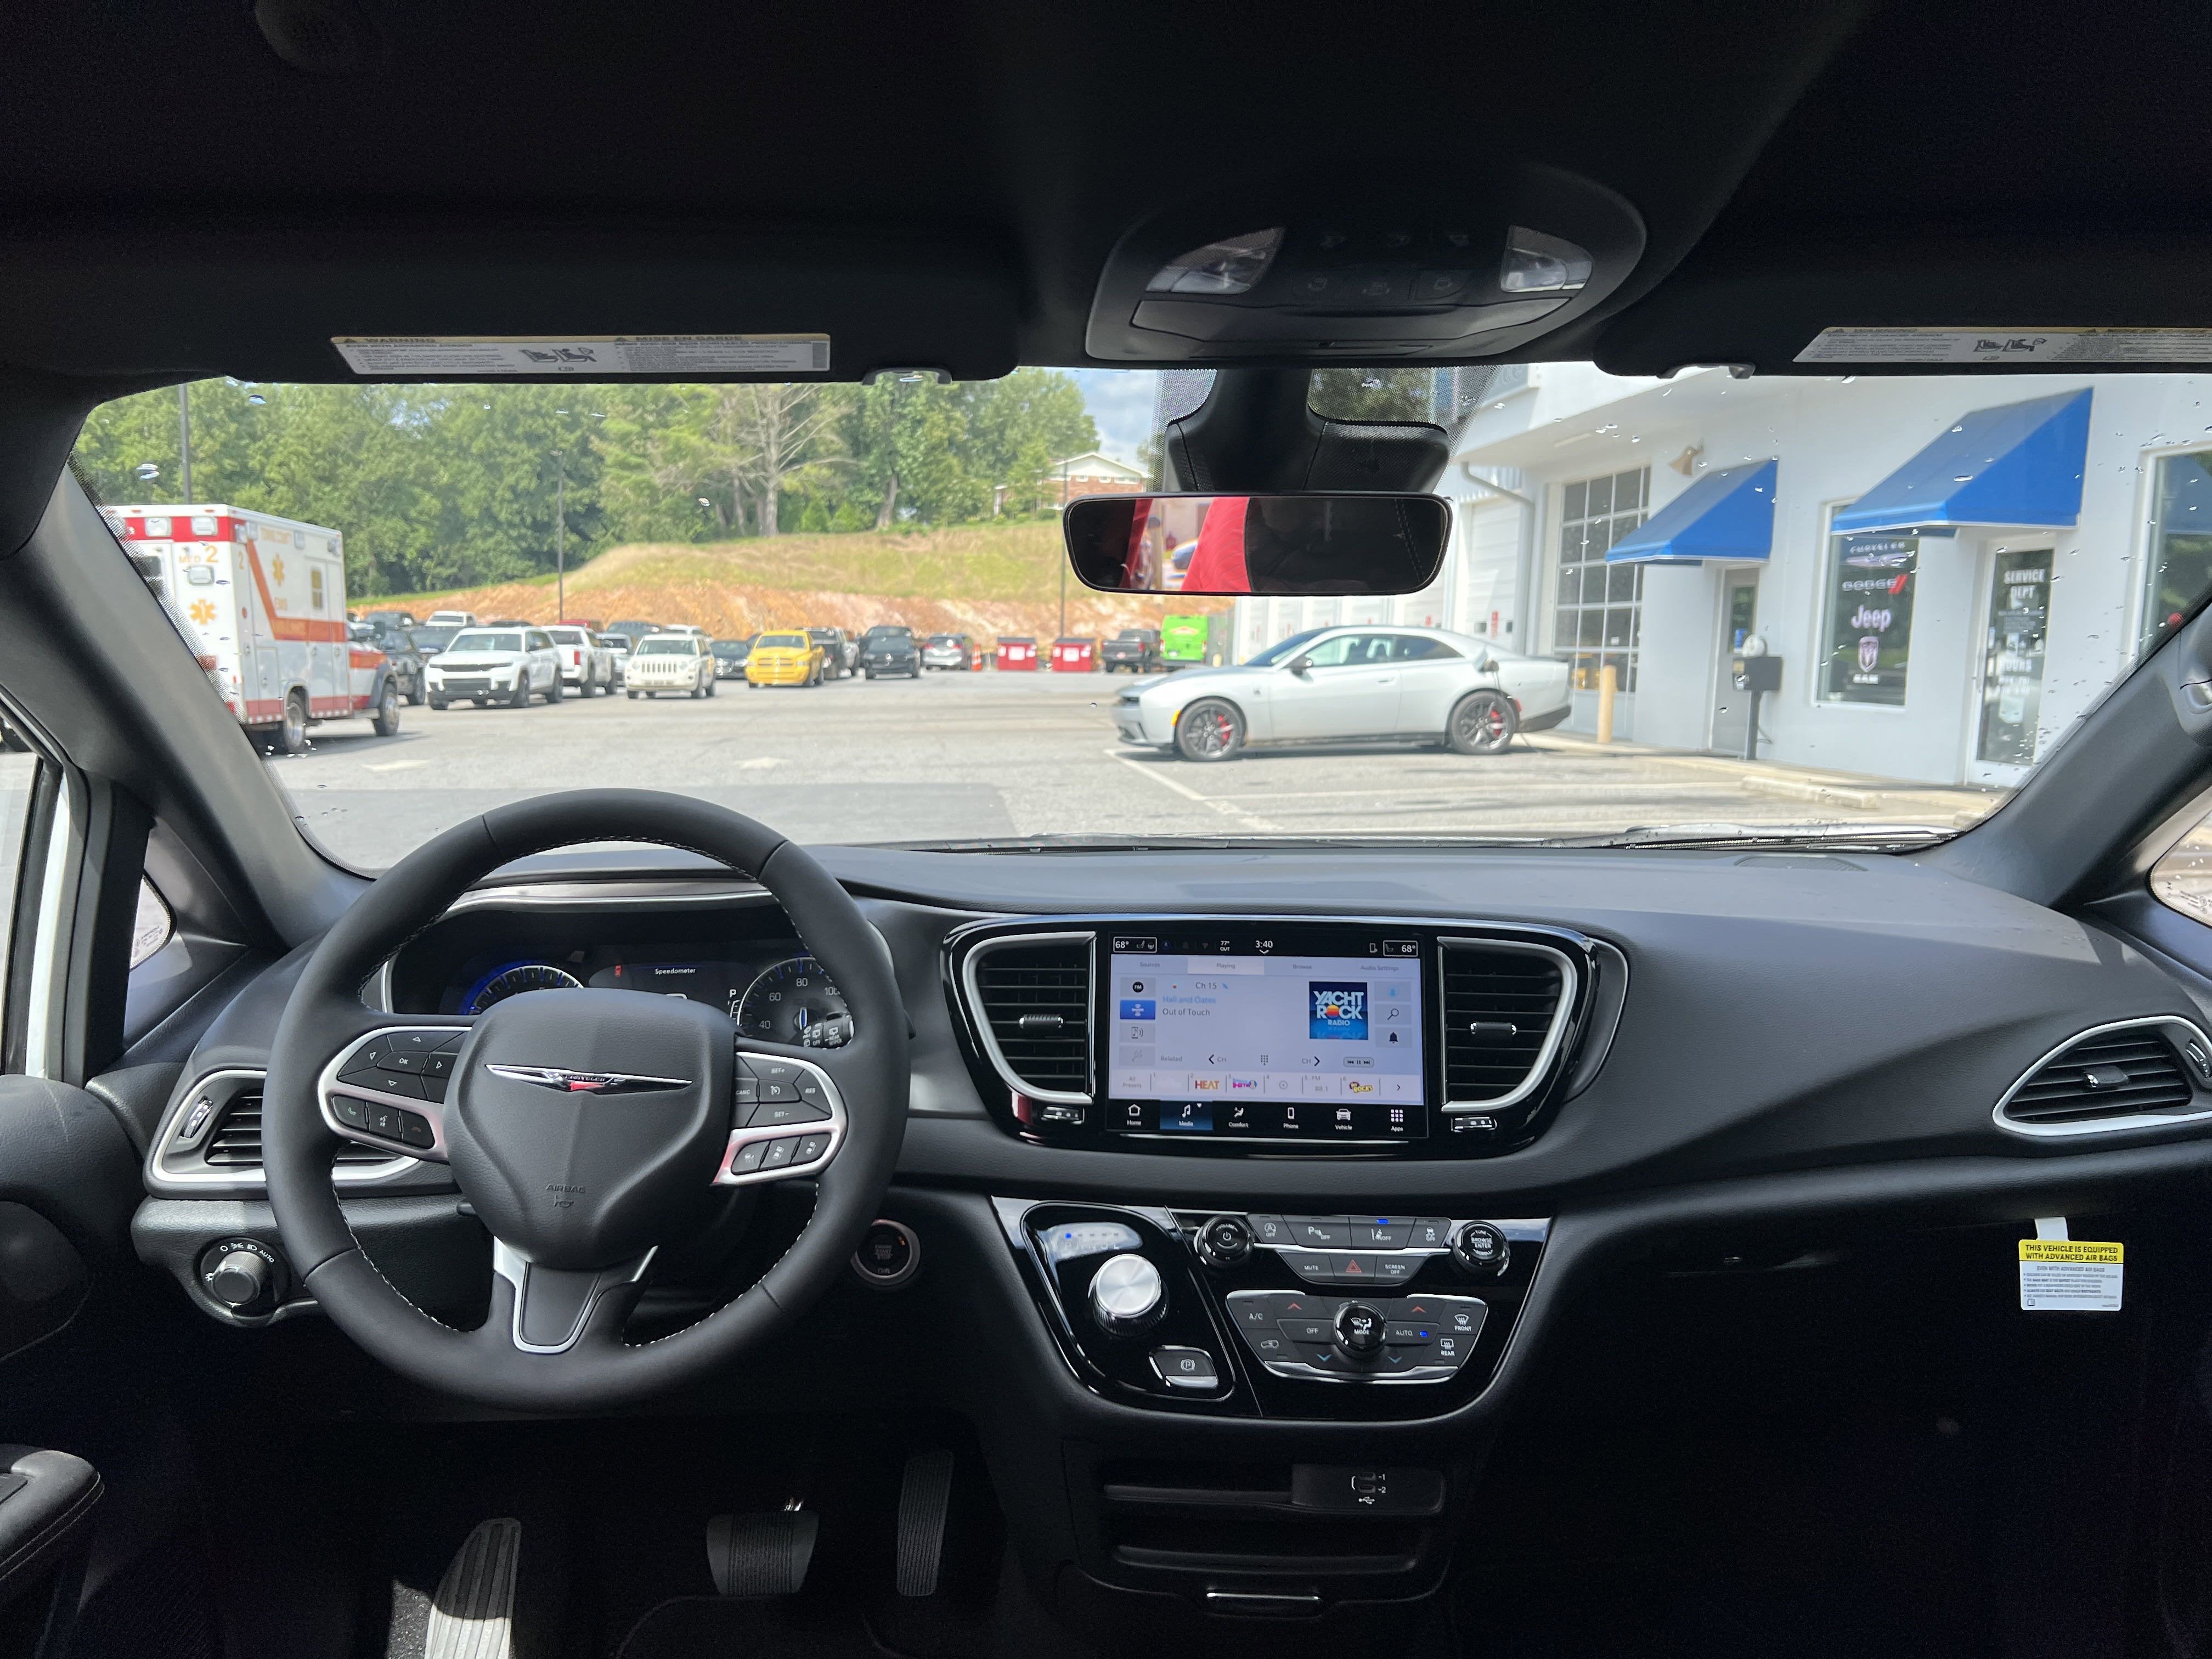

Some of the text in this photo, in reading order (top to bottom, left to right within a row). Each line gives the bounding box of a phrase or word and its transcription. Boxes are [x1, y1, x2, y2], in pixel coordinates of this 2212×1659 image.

[205, 545, 218, 563] 2
[238, 551, 245, 571] 2
[2004, 569, 2045, 584] SERVICE
[1842, 578, 1897, 591] DODGE
[1851, 605, 1892, 632] Jeep
[1255, 940, 1273, 949] 3:40
[1402, 945, 1416, 953] 68°
[796, 978, 808, 987] 80
[729, 989, 737, 997] P
[769, 992, 781, 1001] 60
[1313, 991, 1364, 1005] YACHT
[759, 1020, 771, 1029] 40
[1195, 1080, 1219, 1090] HEAT
[545, 1183, 586, 1194] AIRBAG
[259, 1249, 274, 1263] AUTO
